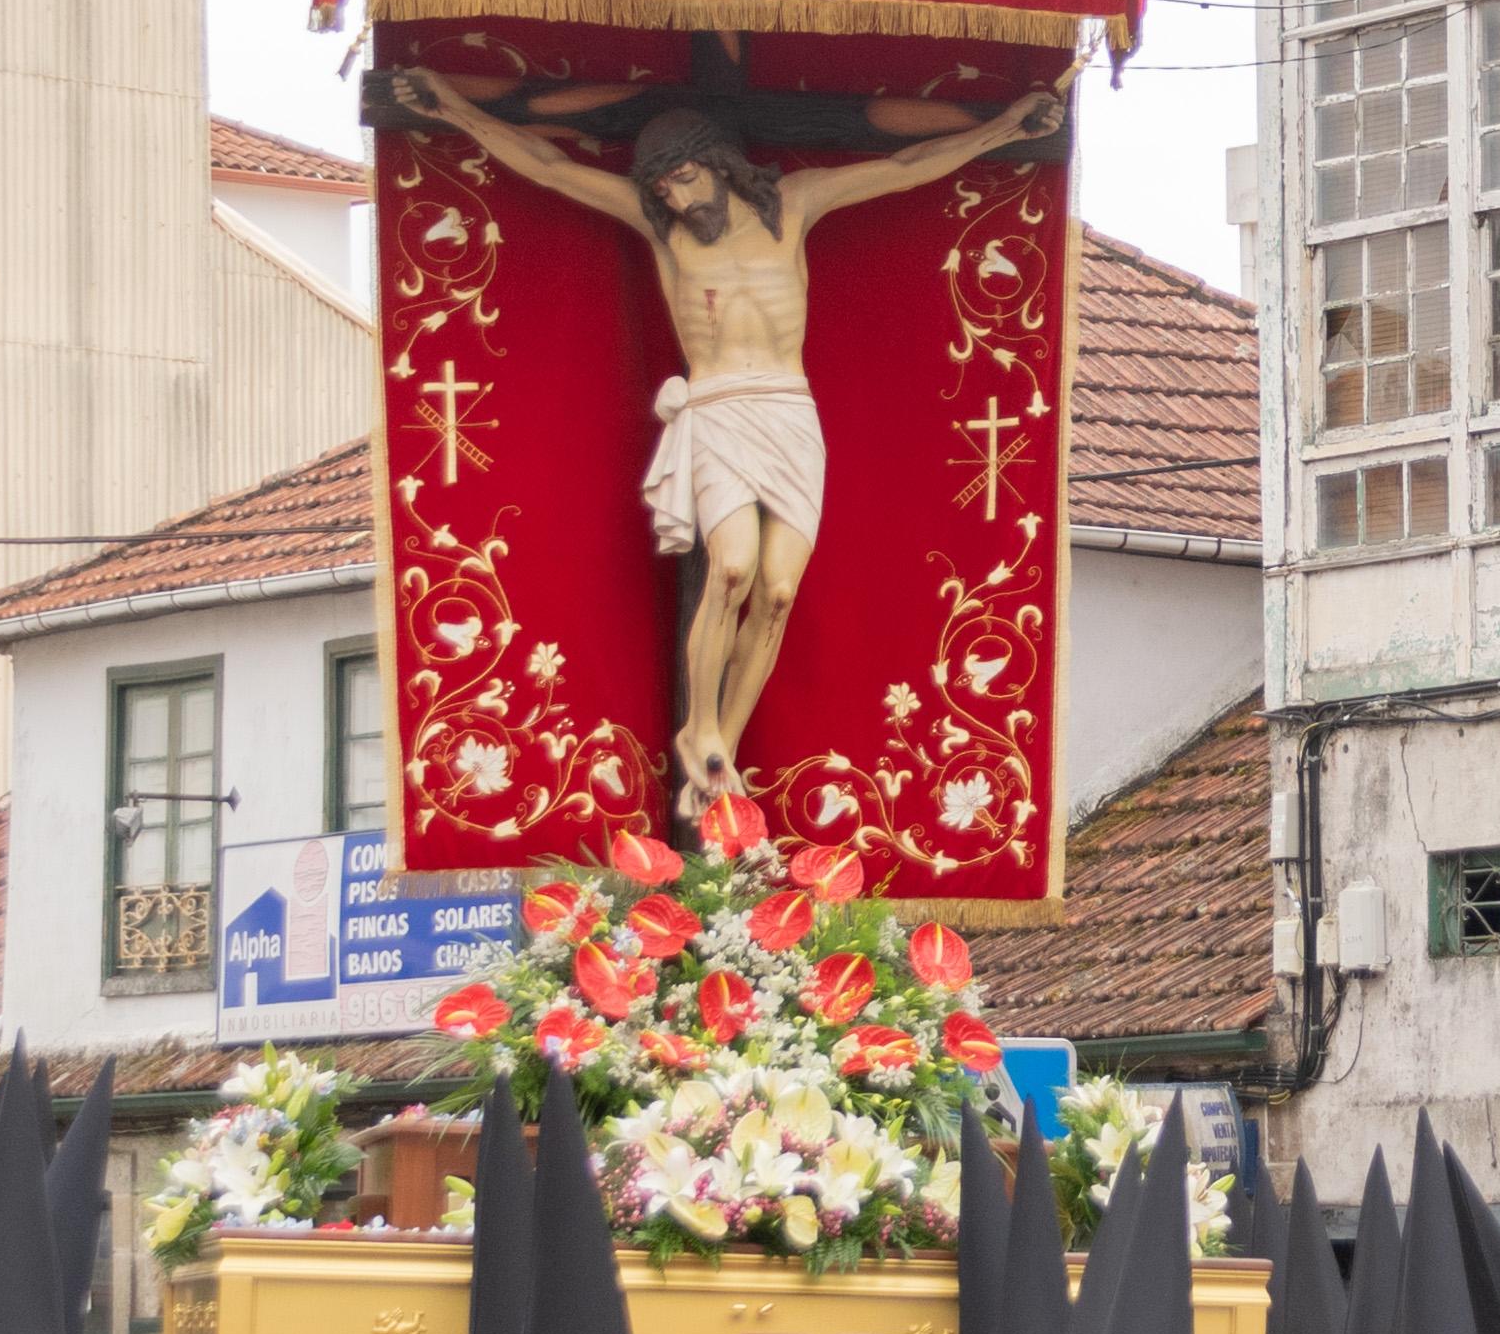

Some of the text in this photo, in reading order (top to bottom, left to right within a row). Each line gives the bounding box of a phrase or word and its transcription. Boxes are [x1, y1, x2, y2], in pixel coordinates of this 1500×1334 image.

[347, 902, 513, 940] FINCAS SOLARES
[229, 929, 281, 968] Alpha
[347, 948, 403, 977] BAJOS
[221, 1012, 339, 1032] INMOBILIARIA
[1211, 1122, 1237, 1140] VENTA
